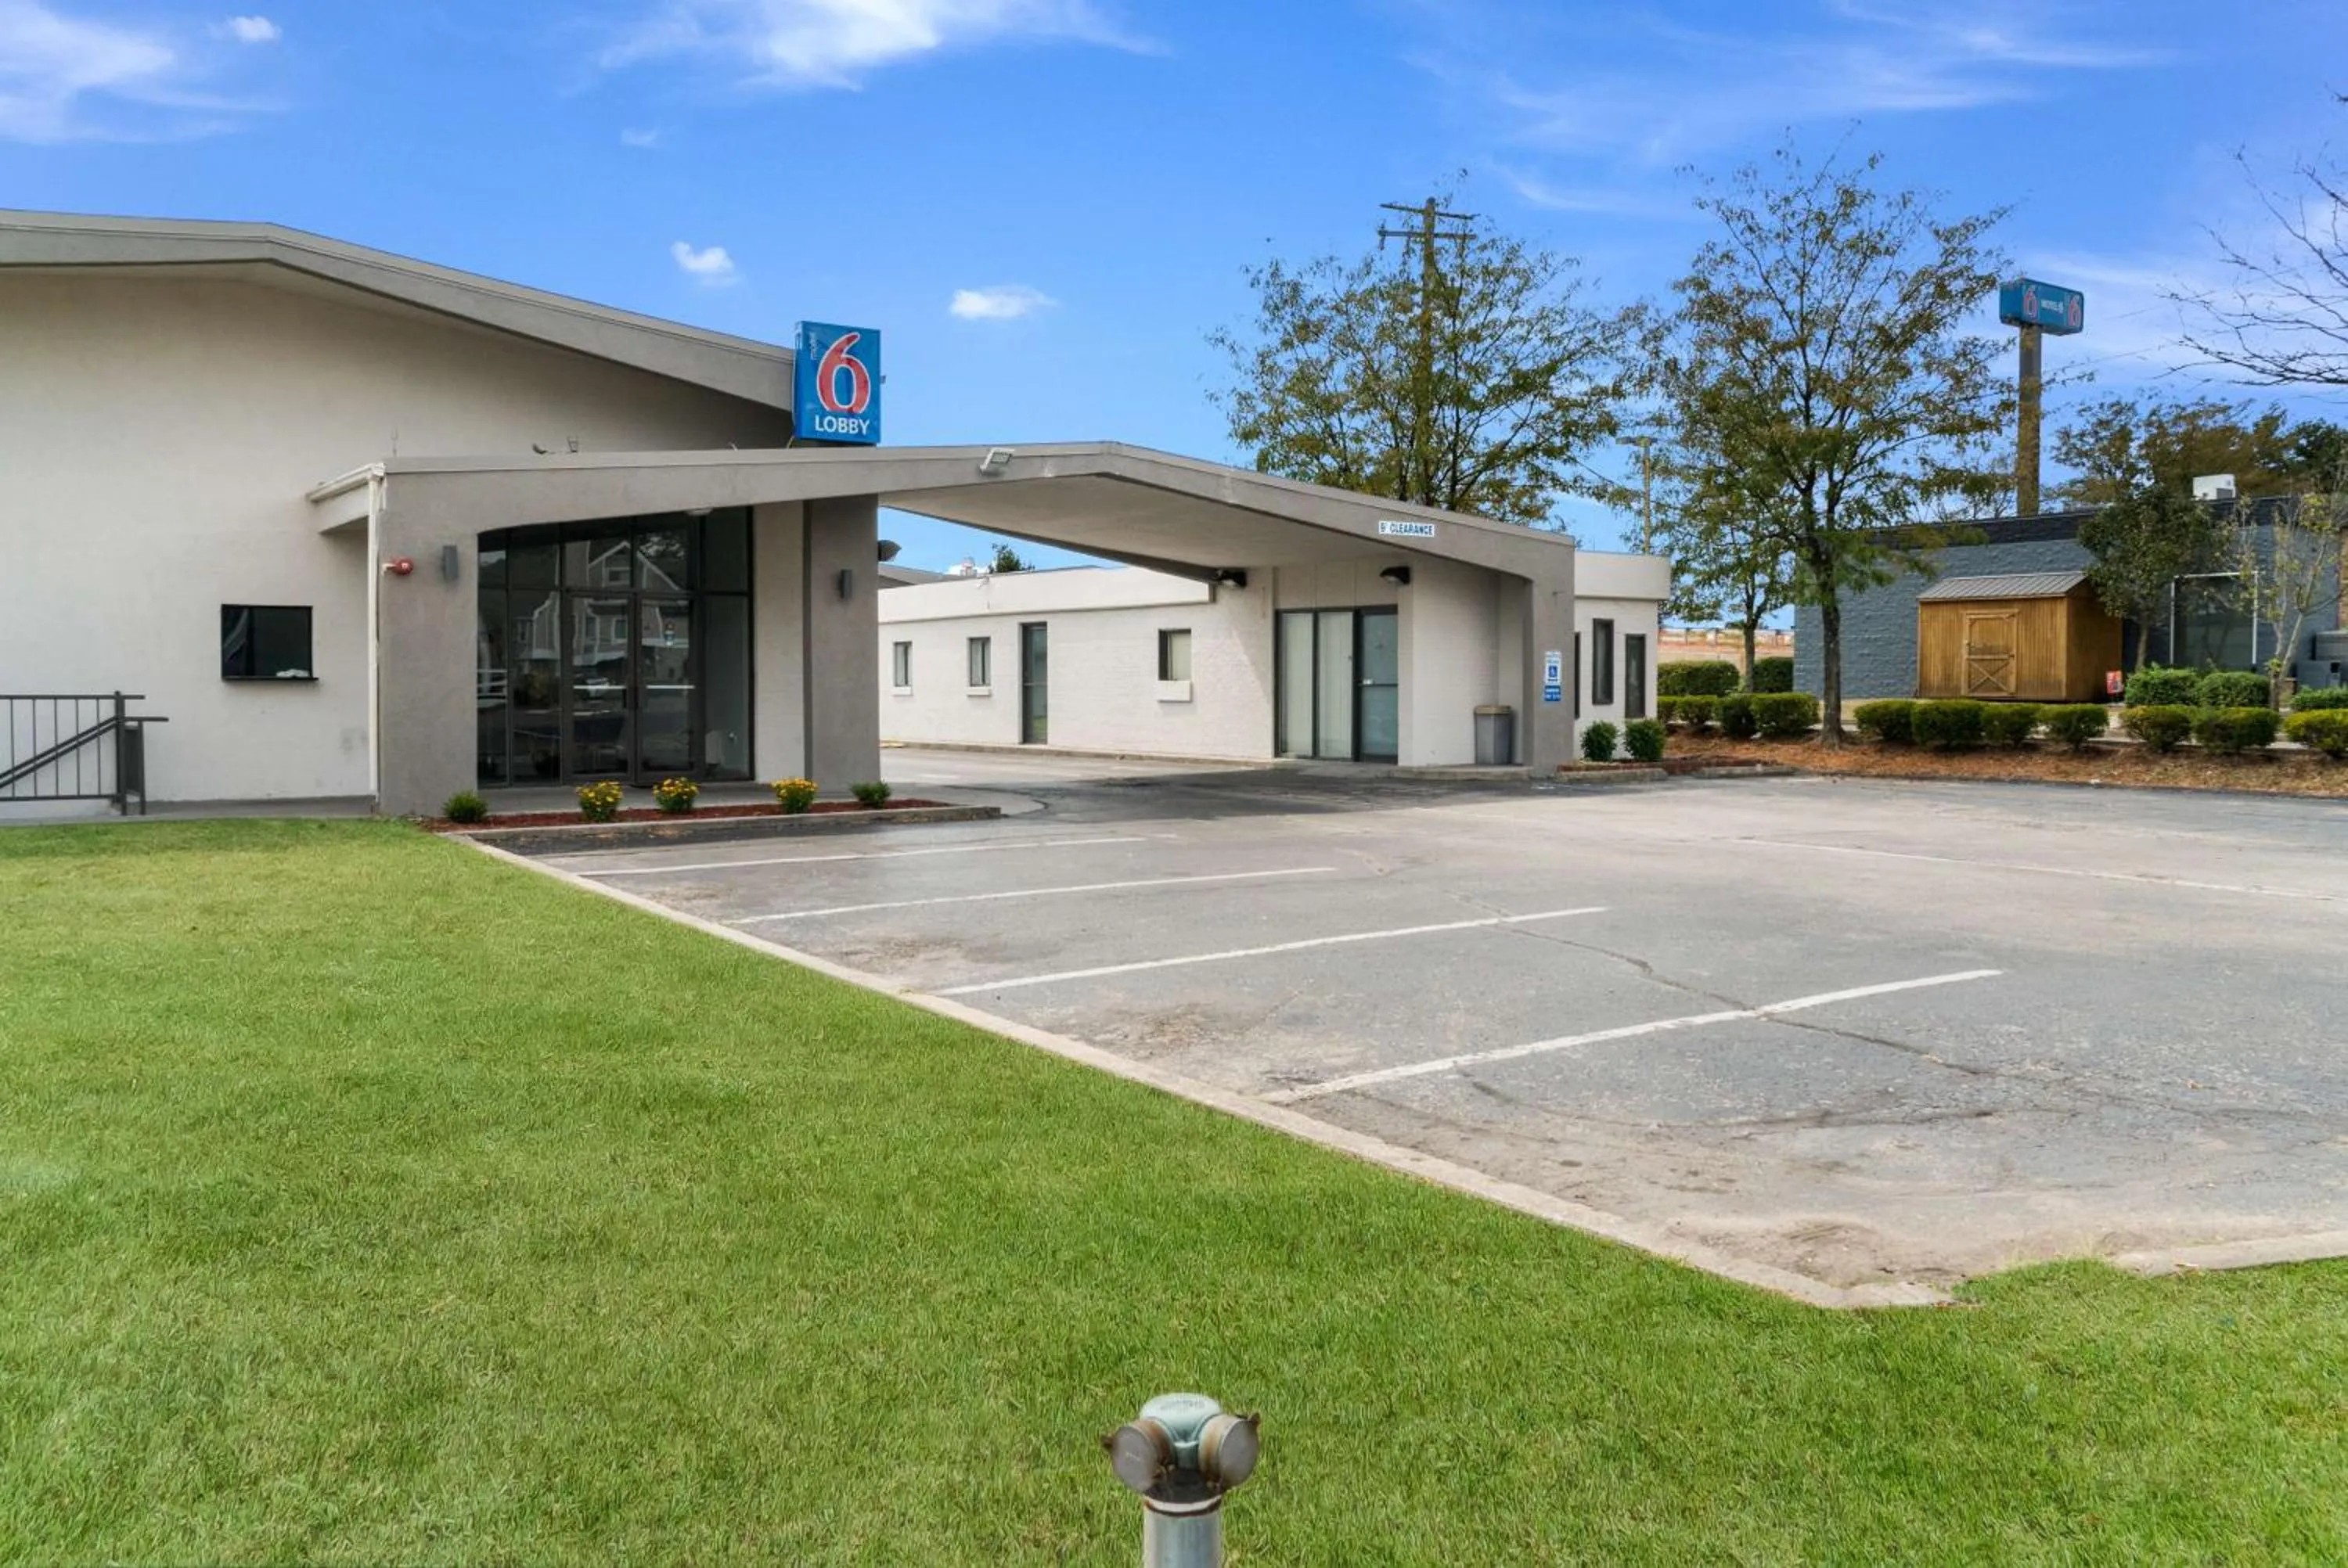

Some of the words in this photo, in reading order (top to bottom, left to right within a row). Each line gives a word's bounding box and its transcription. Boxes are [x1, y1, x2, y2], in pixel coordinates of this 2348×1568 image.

[816, 332, 871, 413] 6
[815, 415, 870, 436] LOBBY
[1389, 523, 1433, 536] CLEARANCE
